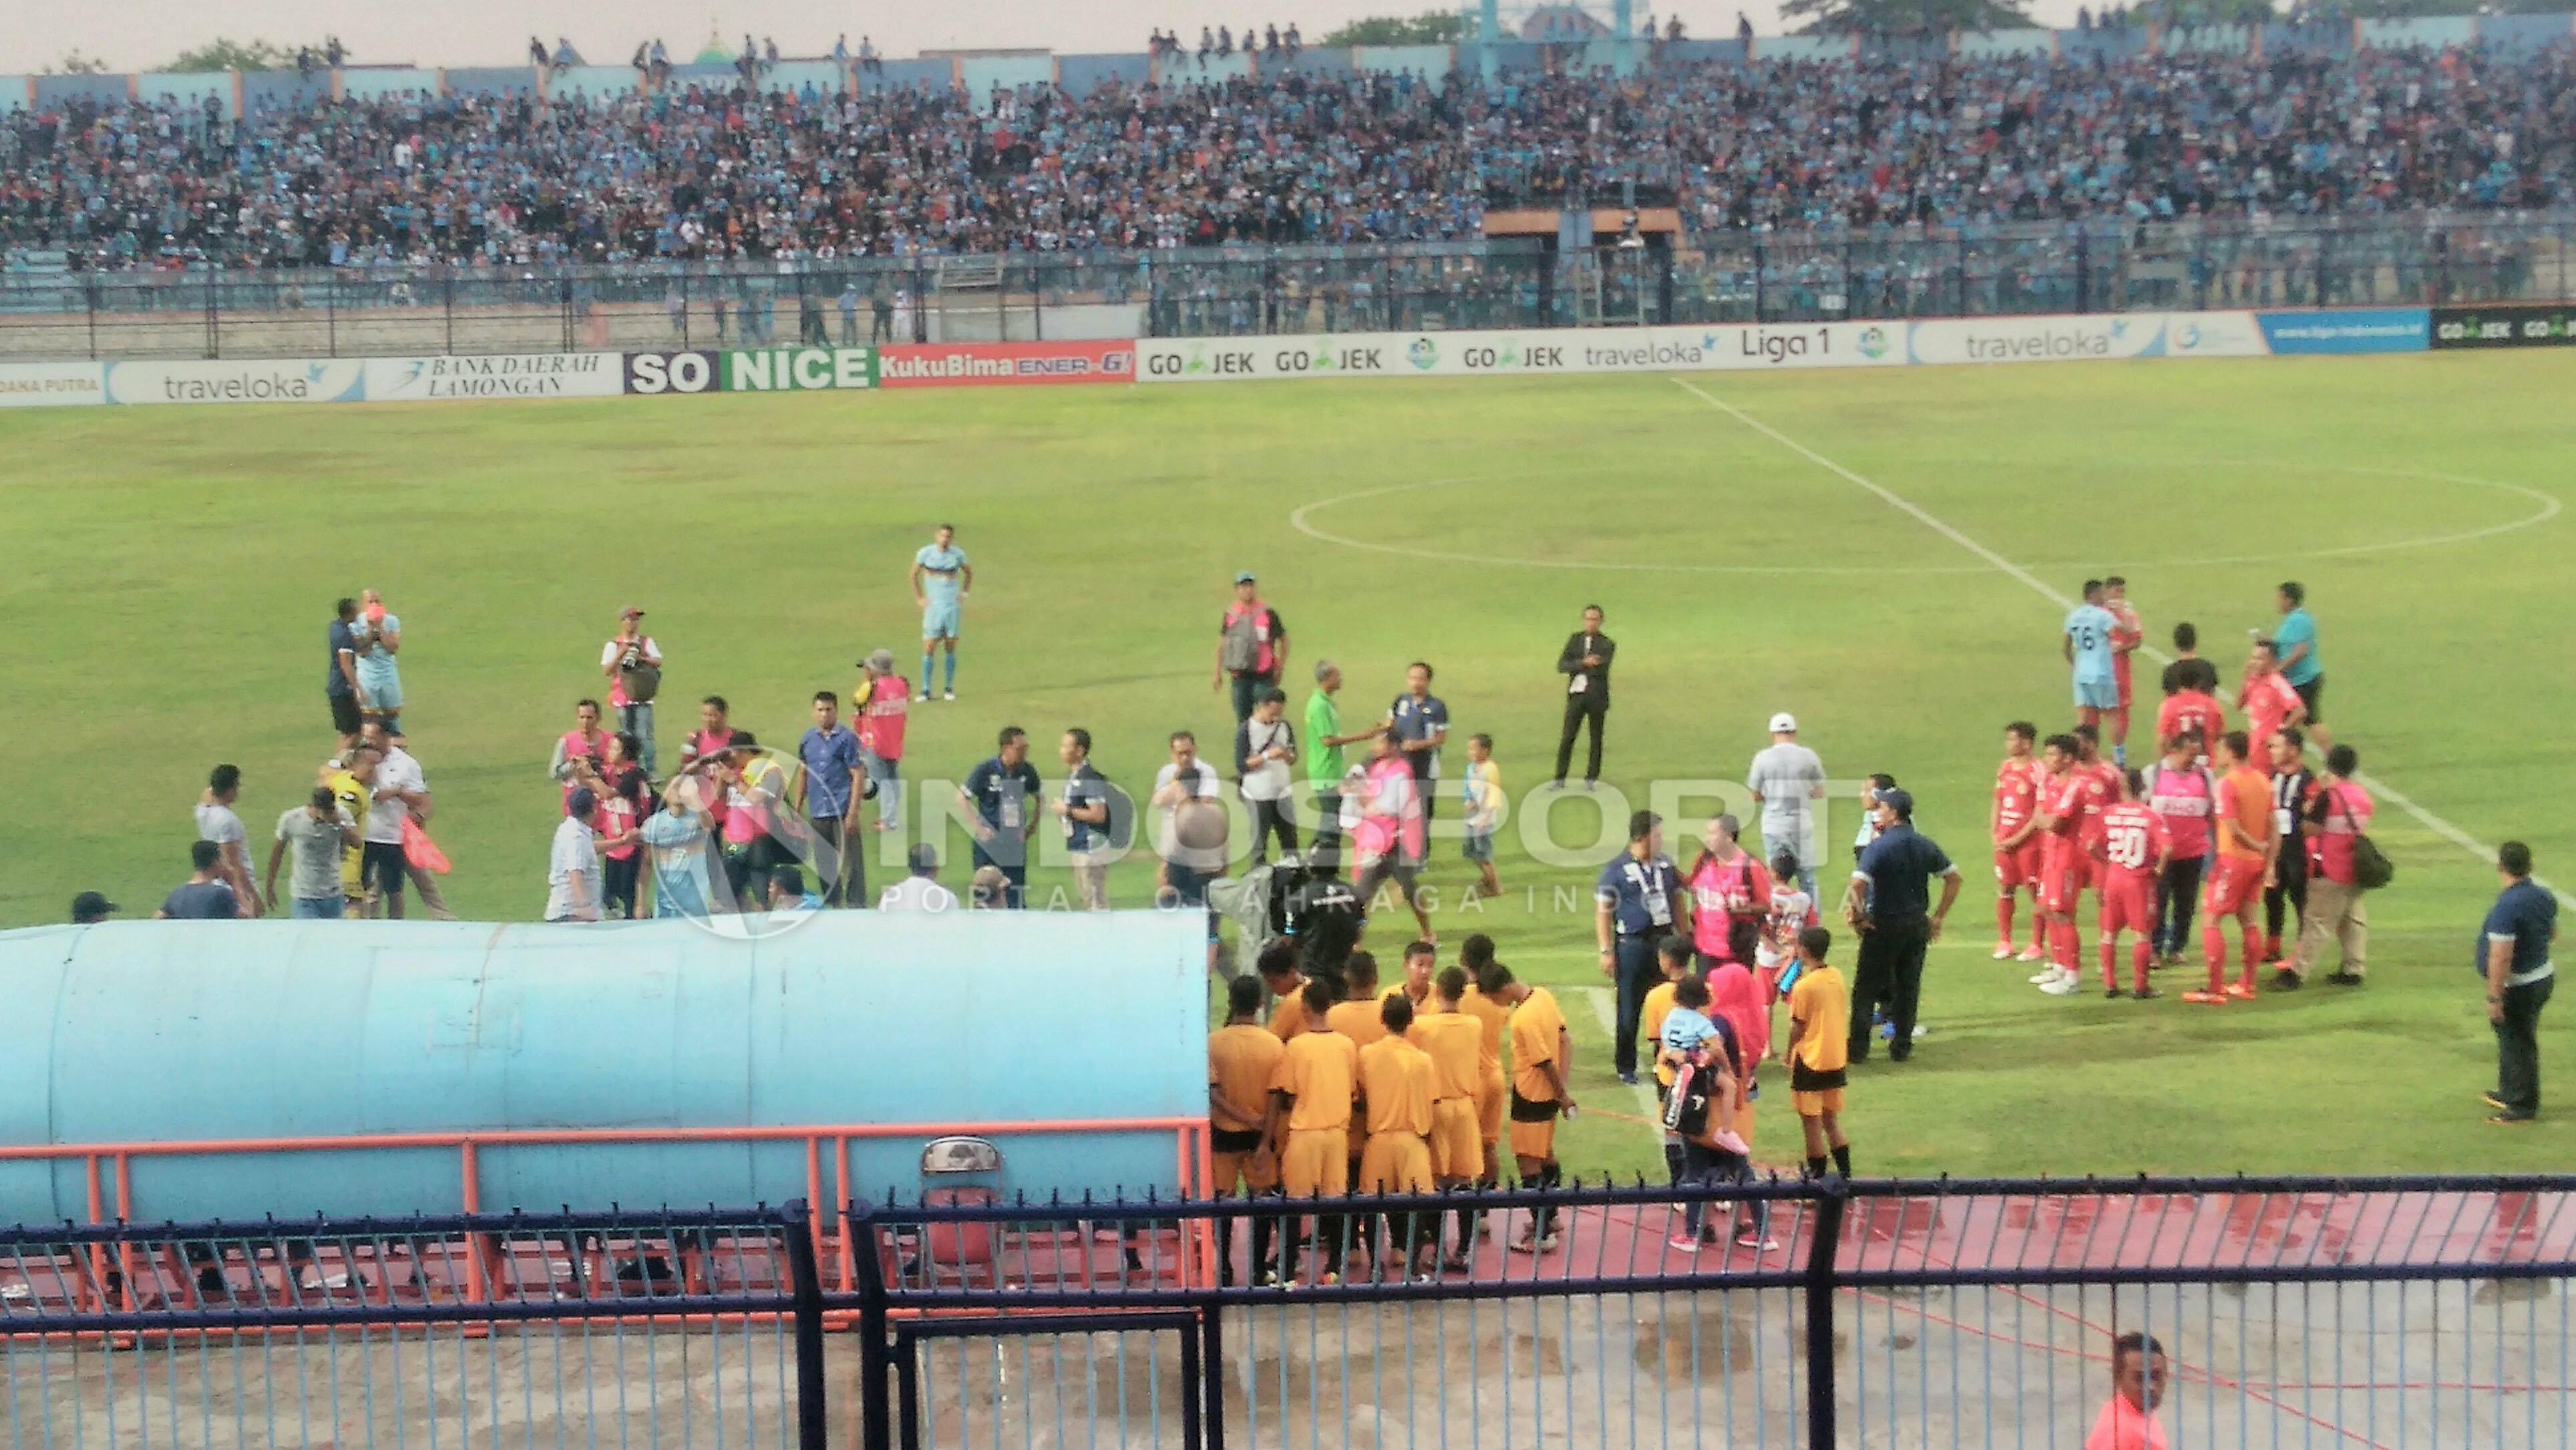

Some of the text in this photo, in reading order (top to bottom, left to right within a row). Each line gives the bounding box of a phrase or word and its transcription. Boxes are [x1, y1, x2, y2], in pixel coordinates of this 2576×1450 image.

[1584, 341, 1702, 366] traveloka
[1742, 328, 1829, 363] Liga 1
[1967, 329, 2109, 358] traveloka
[432, 355, 599, 375] BANK DAERAH
[880, 354, 1014, 377] KukuBima
[1149, 353, 1254, 375] GO JEK
[1276, 349, 1381, 371] GO JEK
[1464, 347, 1563, 367] GO JEK
[631, 352, 710, 393] SO
[731, 349, 868, 391] NICE
[165, 373, 308, 399] traveloka
[429, 376, 564, 397] LAMONGAN
[2108, 827, 2146, 870] 20
